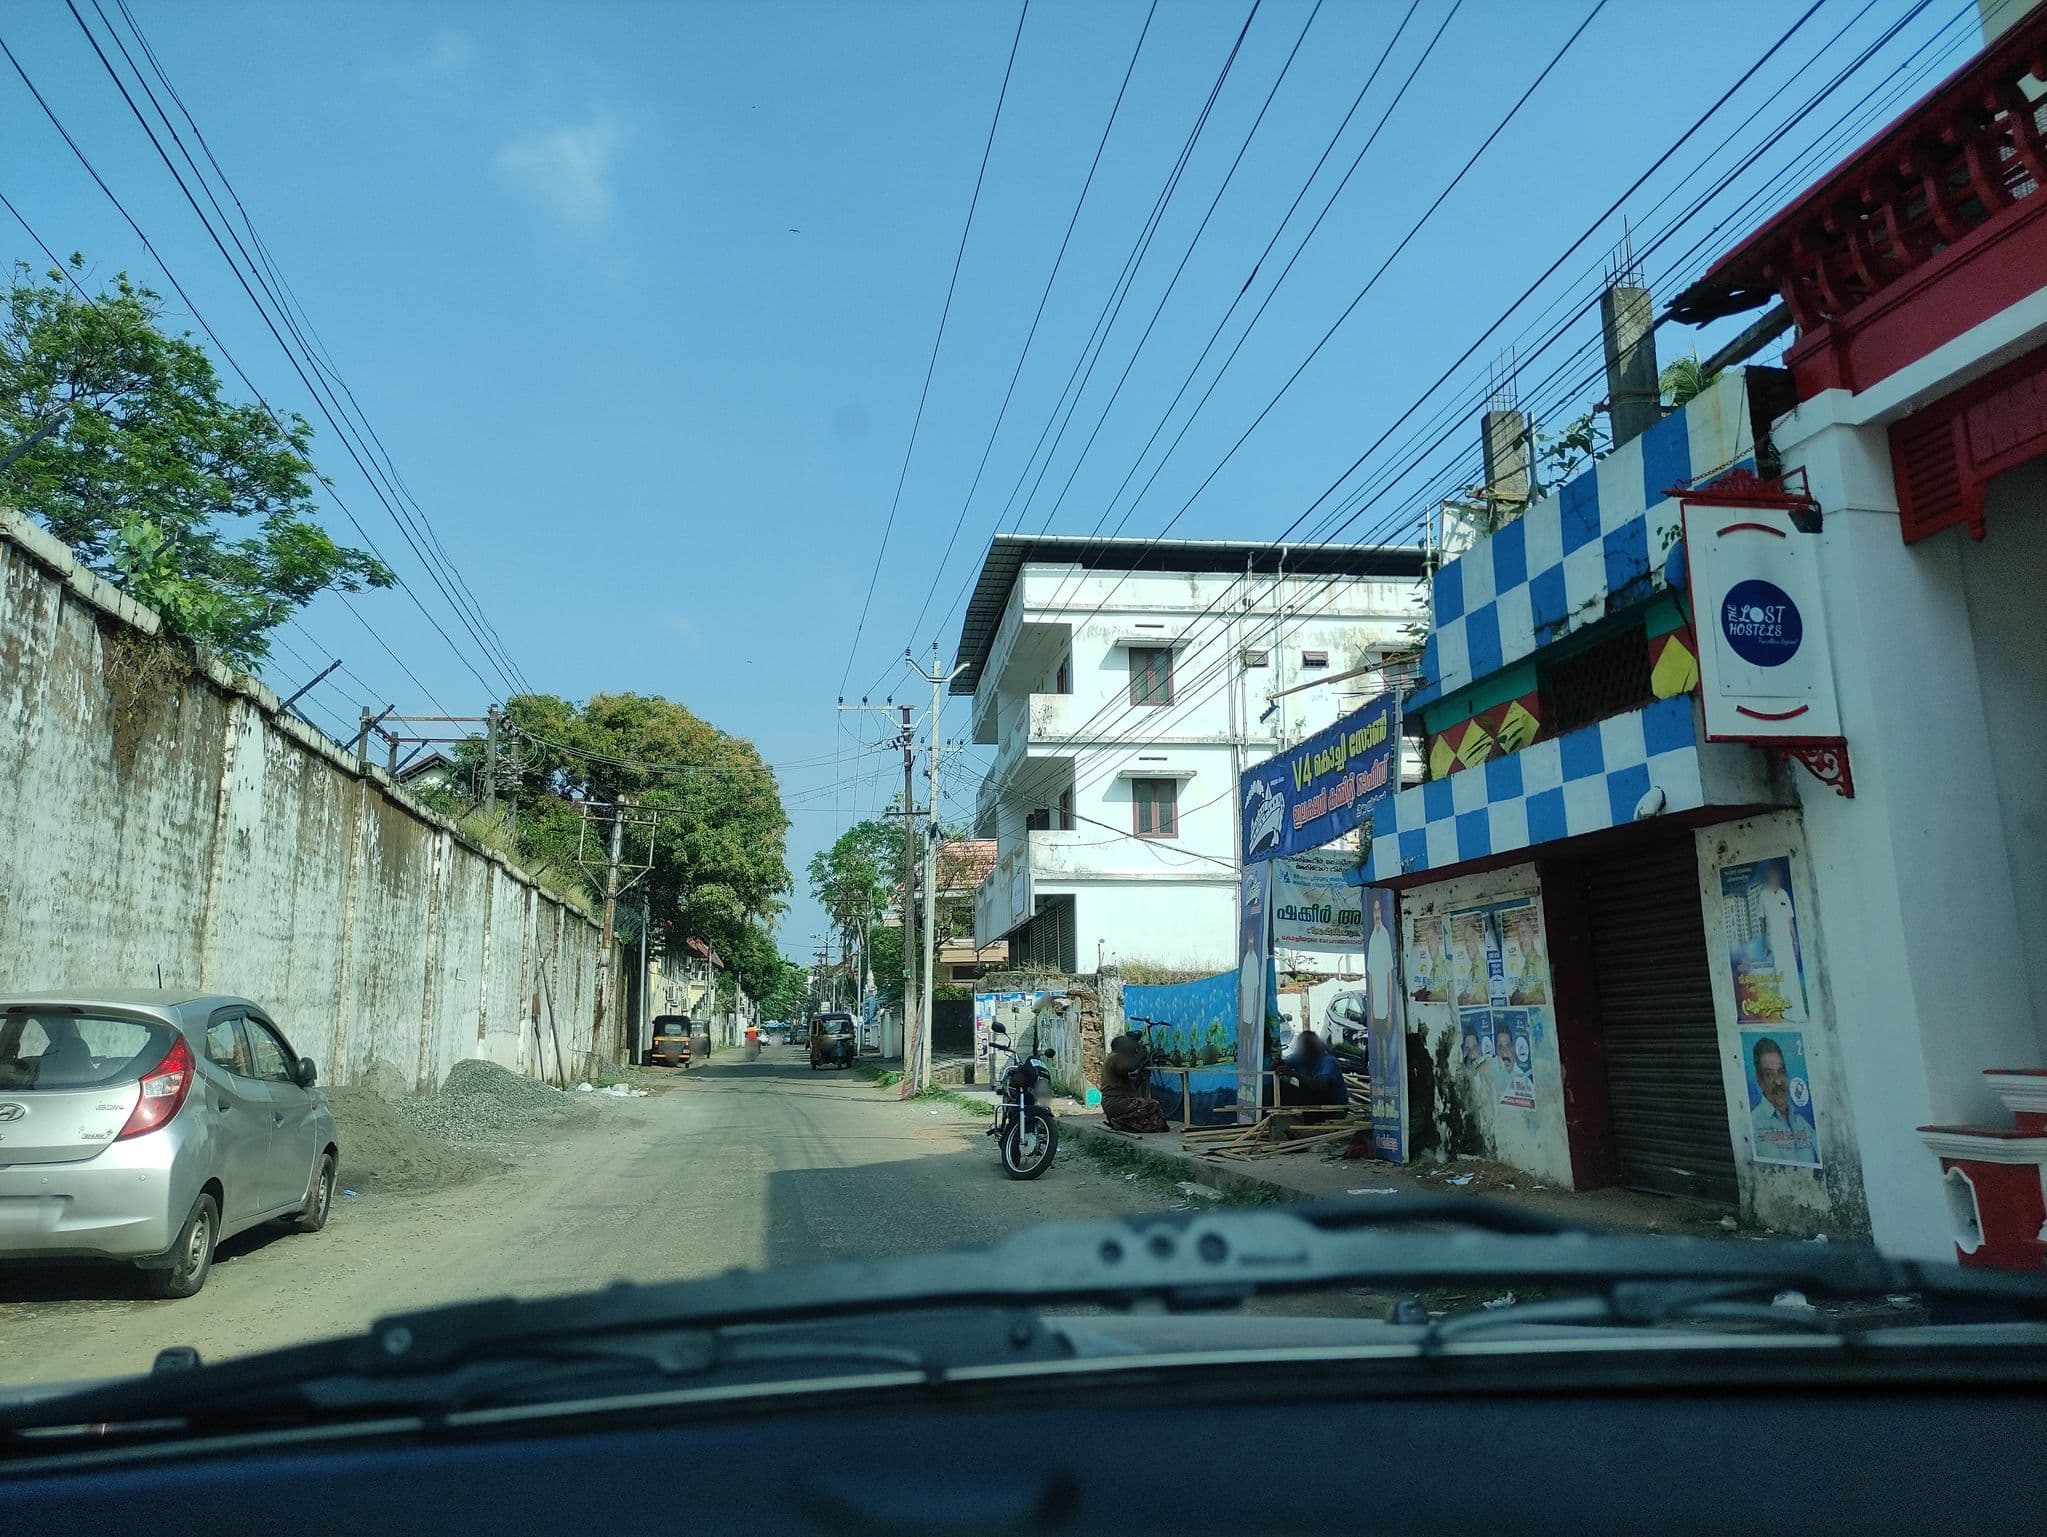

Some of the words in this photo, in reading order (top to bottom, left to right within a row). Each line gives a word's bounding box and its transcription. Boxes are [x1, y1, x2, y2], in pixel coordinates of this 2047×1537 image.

[1727, 604, 1738, 622] THE
[1738, 604, 1786, 624] LOST
[1729, 623, 1782, 637] HOSTELS
[1292, 752, 1312, 792] V4
[1314, 733, 1346, 777] കൊച്ചി
[1277, 904, 1331, 923] ഷക്കീർ
